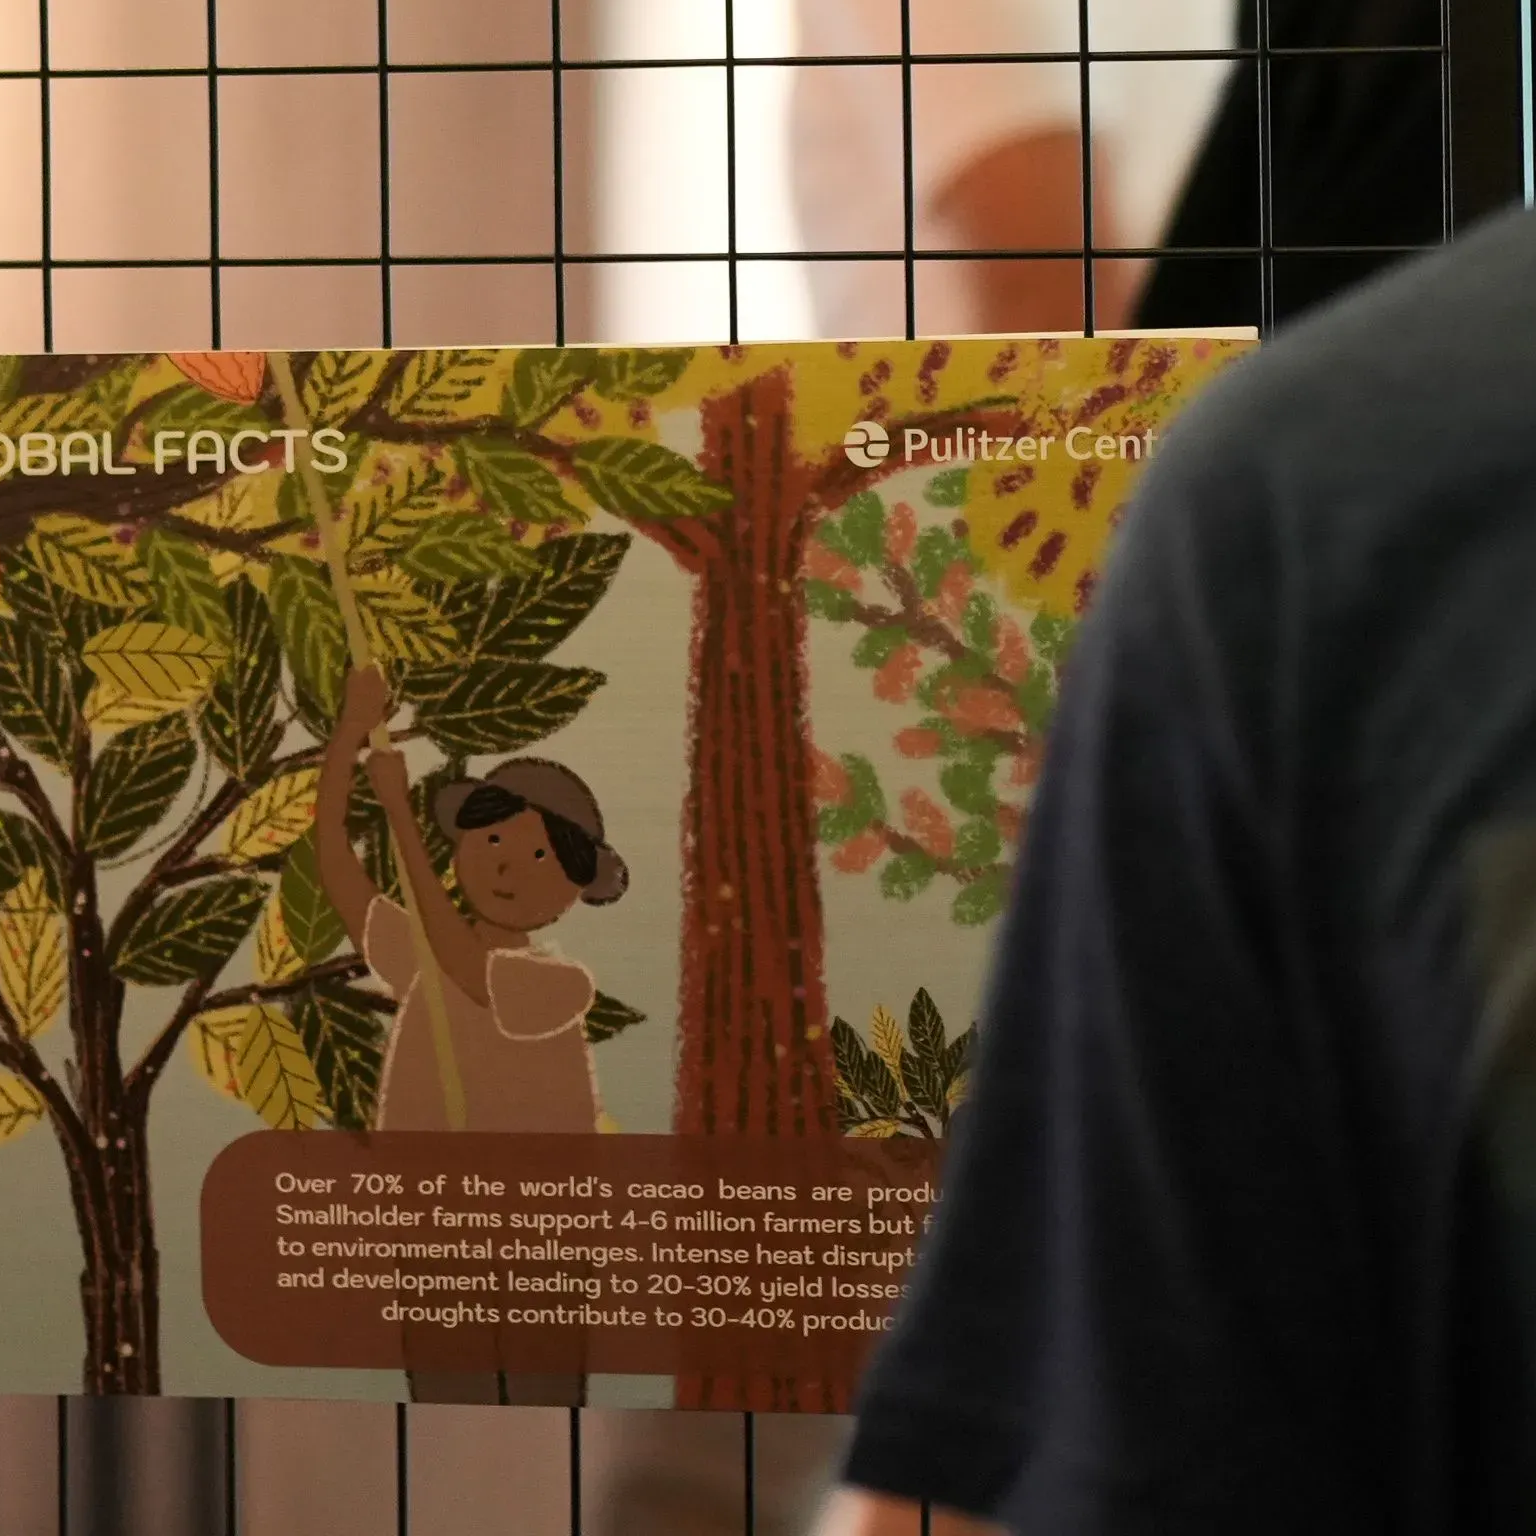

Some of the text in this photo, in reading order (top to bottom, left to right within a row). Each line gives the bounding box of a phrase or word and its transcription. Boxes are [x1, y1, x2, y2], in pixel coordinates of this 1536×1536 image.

[153, 428, 348, 476] FACTS
[904, 426, 1160, 463] Pulitzer Cent
[275, 1172, 945, 1210] Over 70% of the world's cacao beans are produ
[276, 1203, 425, 1227] Smallholder
[431, 1205, 503, 1228] farms
[509, 1209, 613, 1237] support
[620, 1209, 668, 1231] 4-6
[674, 1210, 756, 1232] million
[762, 1211, 862, 1234] farmers
[868, 1212, 915, 1235] but
[276, 1236, 306, 1257] to
[311, 1237, 493, 1260] environmental
[499, 1238, 644, 1268] challenges.
[651, 1242, 750, 1264] Intense
[756, 1242, 815, 1265] heat
[277, 1267, 325, 1288] and
[331, 1267, 500, 1297] development
[508, 1270, 602, 1300] leading
[609, 1273, 639, 1294] to
[647, 1273, 752, 1296] 20-30%
[760, 1275, 823, 1303] yield
[381, 1299, 896, 1337] droughts contribute to 30-40% produc
